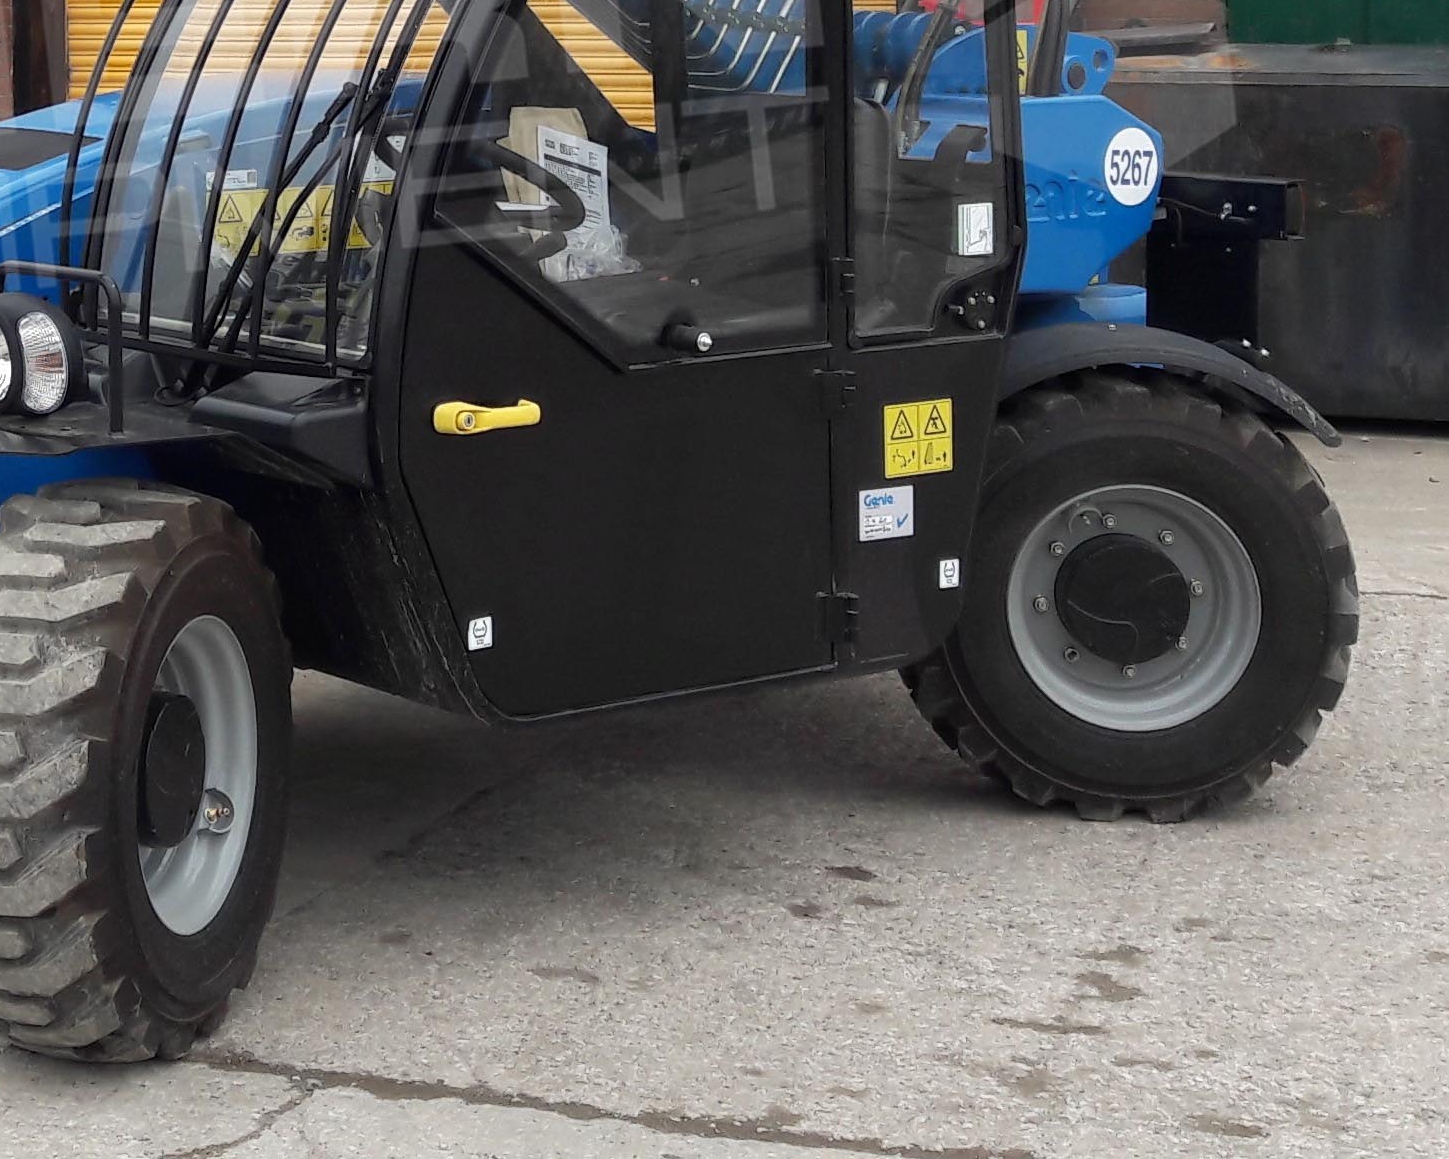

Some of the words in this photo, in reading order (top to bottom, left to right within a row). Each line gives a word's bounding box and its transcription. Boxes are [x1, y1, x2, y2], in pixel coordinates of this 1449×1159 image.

[1109, 149, 1154, 187] 5267
[1026, 169, 1107, 222] enie
[864, 493, 894, 508] Genie
